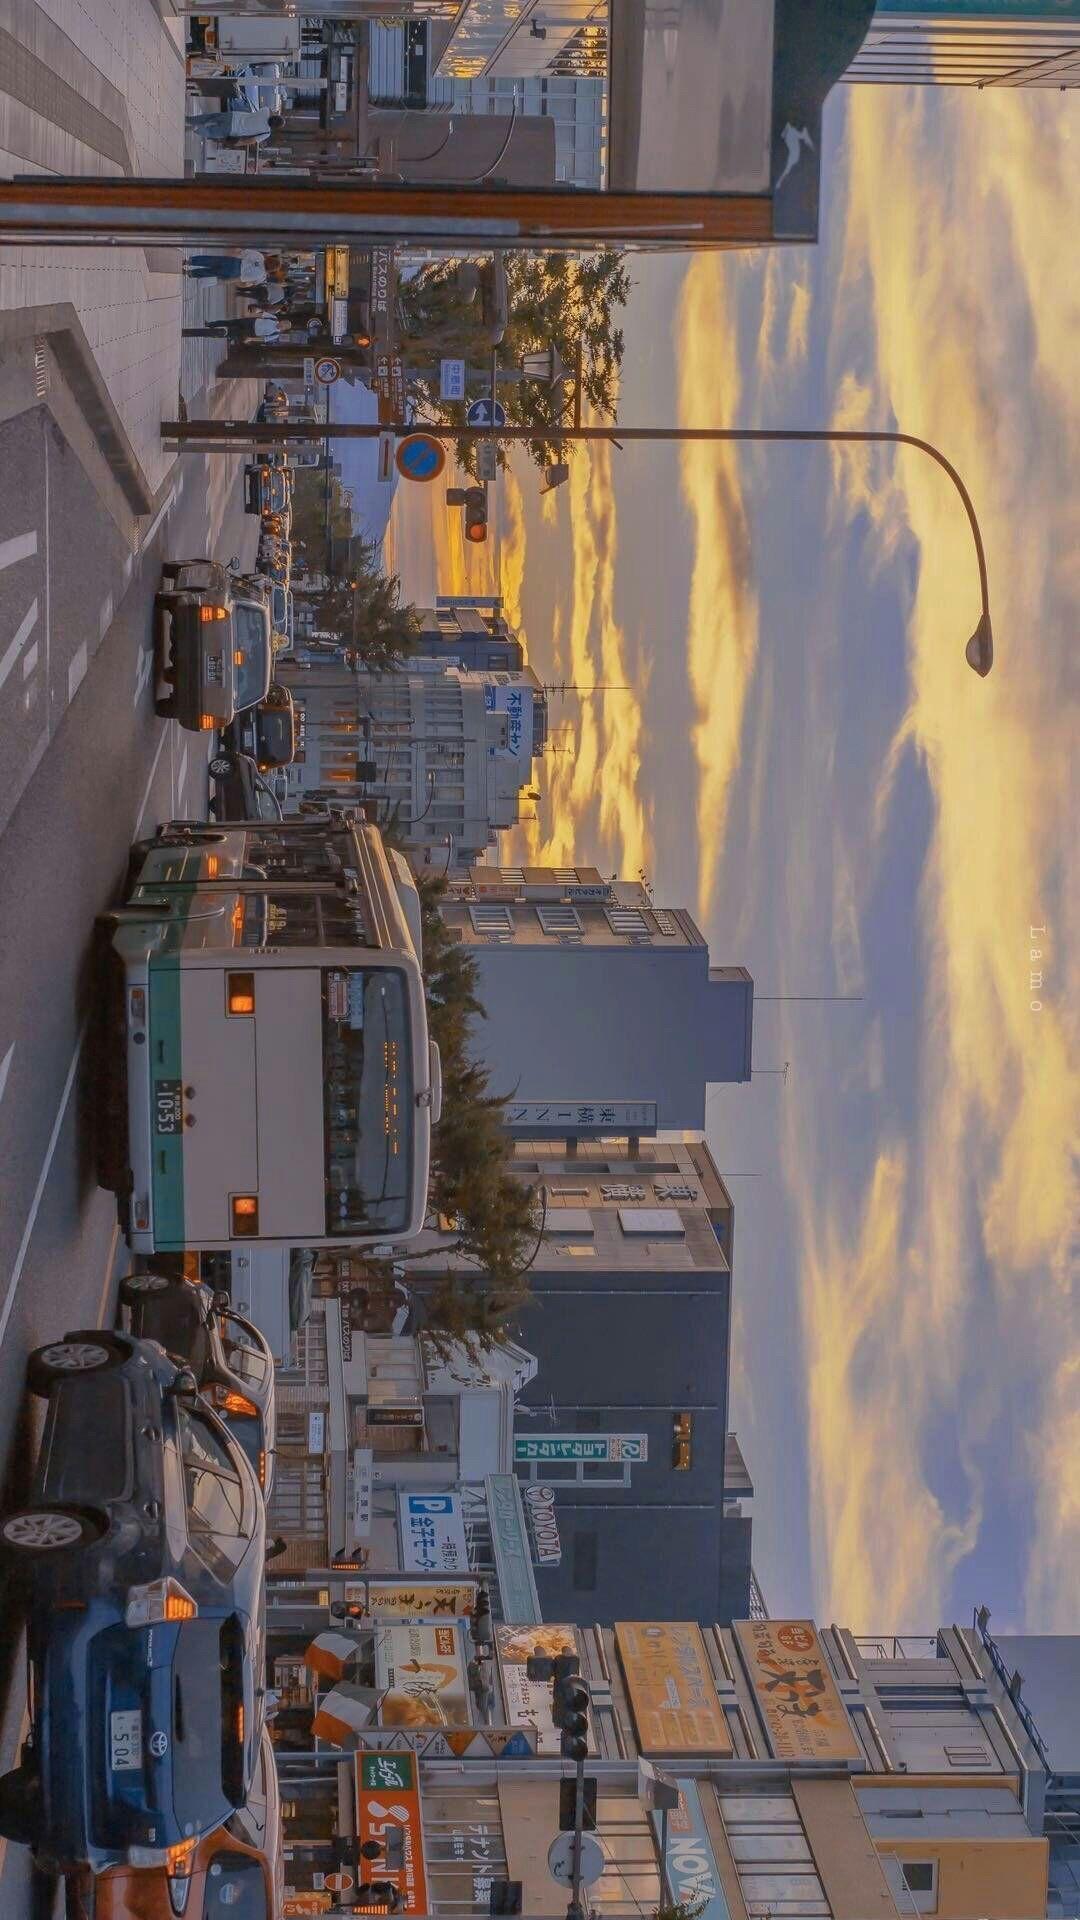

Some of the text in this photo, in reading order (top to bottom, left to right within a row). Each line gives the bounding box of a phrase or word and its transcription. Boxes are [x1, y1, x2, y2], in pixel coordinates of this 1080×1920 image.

[378, 251, 389, 312] バスのりば
[157, 1091, 176, 1133] 10-53
[516, 1443, 606, 1457] トヨタレンタカー
[411, 1517, 437, 1571] 金子モータ
[532, 1504, 560, 1557] TOYOTA
[666, 1837, 717, 1908] NOVA
